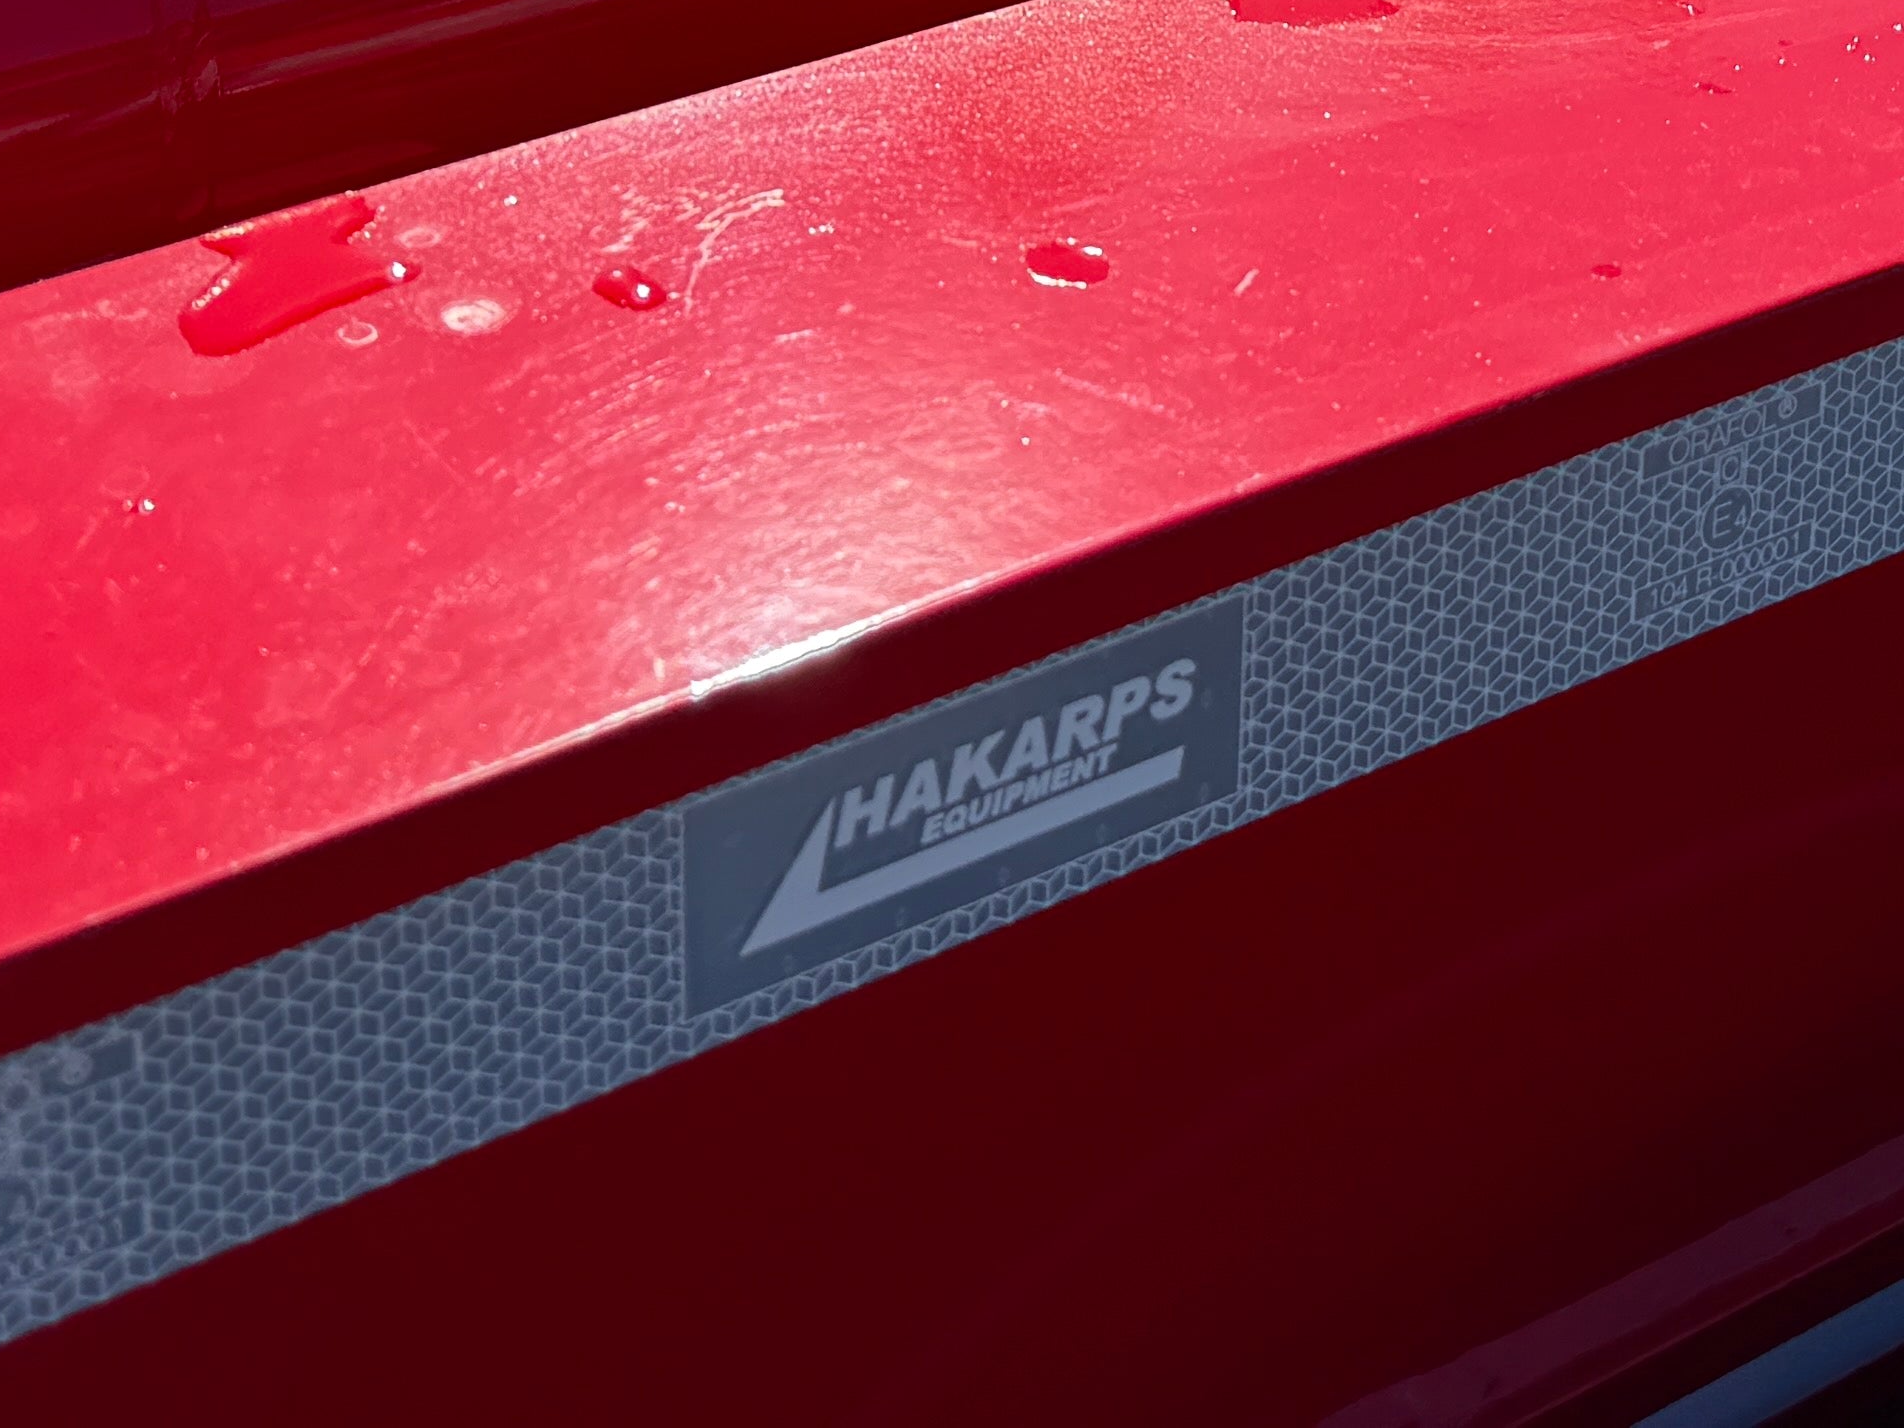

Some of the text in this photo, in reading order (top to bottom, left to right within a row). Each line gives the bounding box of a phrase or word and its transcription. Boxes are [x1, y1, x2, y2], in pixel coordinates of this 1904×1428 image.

[1652, 574, 1689, 611] 104
[833, 657, 1198, 850] HAKARPS
[921, 743, 1118, 846] EQUIPMENT
